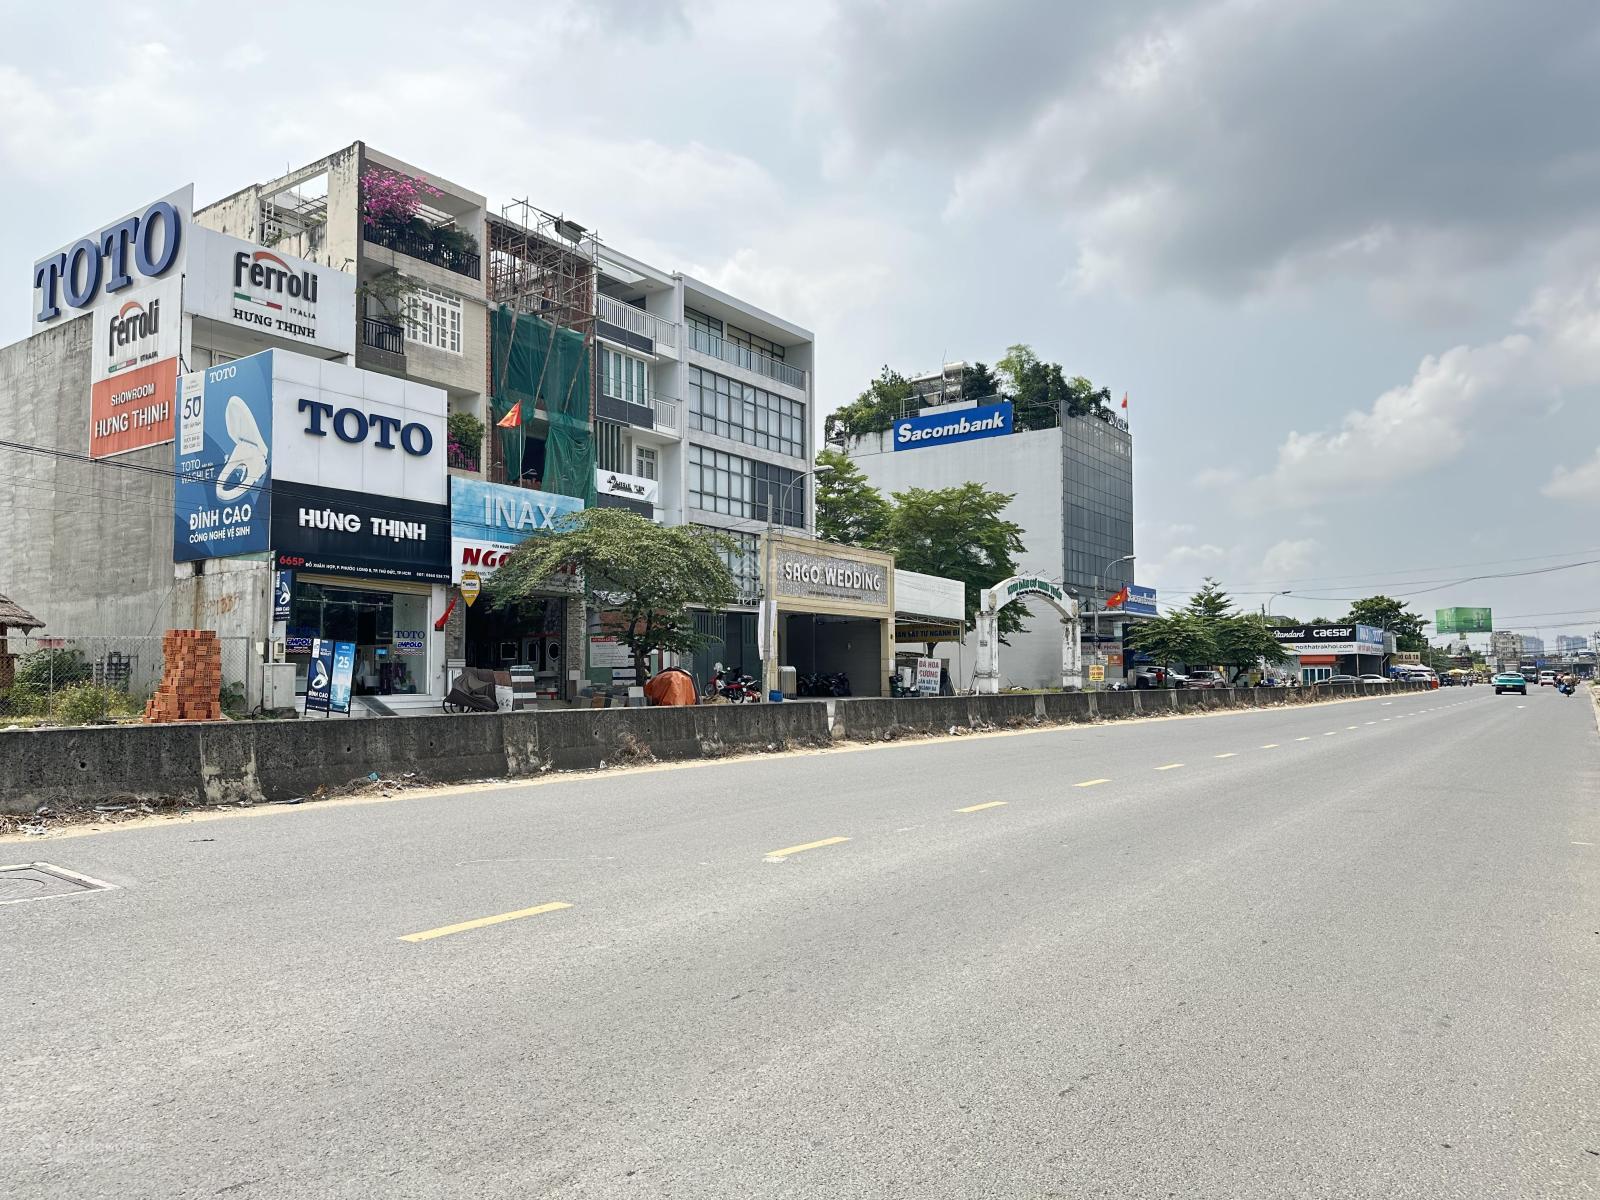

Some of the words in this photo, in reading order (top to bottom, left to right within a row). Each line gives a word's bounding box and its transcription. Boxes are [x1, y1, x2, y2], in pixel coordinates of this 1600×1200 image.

[34, 201, 181, 322] TOTO
[234, 251, 317, 303] Ferroli
[289, 307, 316, 319] ITALIA
[109, 298, 159, 356] Ferroli
[275, 319, 316, 338] THỊNH
[209, 366, 237, 384] TOTO
[111, 383, 155, 406] SHOWROOM
[183, 396, 202, 419] 50
[94, 412, 129, 440] HƯNG
[132, 401, 170, 430] THỊNH
[298, 398, 433, 456] TOTO
[897, 411, 1005, 443] Sacombank
[181, 458, 201, 472] TOTO
[190, 506, 219, 530] ĐỈNH
[222, 503, 251, 525] CAO
[483, 495, 557, 532] INAX
[189, 531, 208, 543] CÔNG
[209, 527, 226, 541] NGHỆ
[227, 526, 235, 540] VỆ
[236, 525, 250, 537] SINH
[299, 508, 361, 532] HƯNG
[370, 517, 427, 543] THỊNH
[279, 555, 305, 566] 665P
[785, 562, 820, 584] SAGO
[825, 566, 881, 591] WEDDING
[395, 630, 426, 639] TOTO
[1312, 628, 1353, 637] caesar
[338, 656, 349, 669] 25
